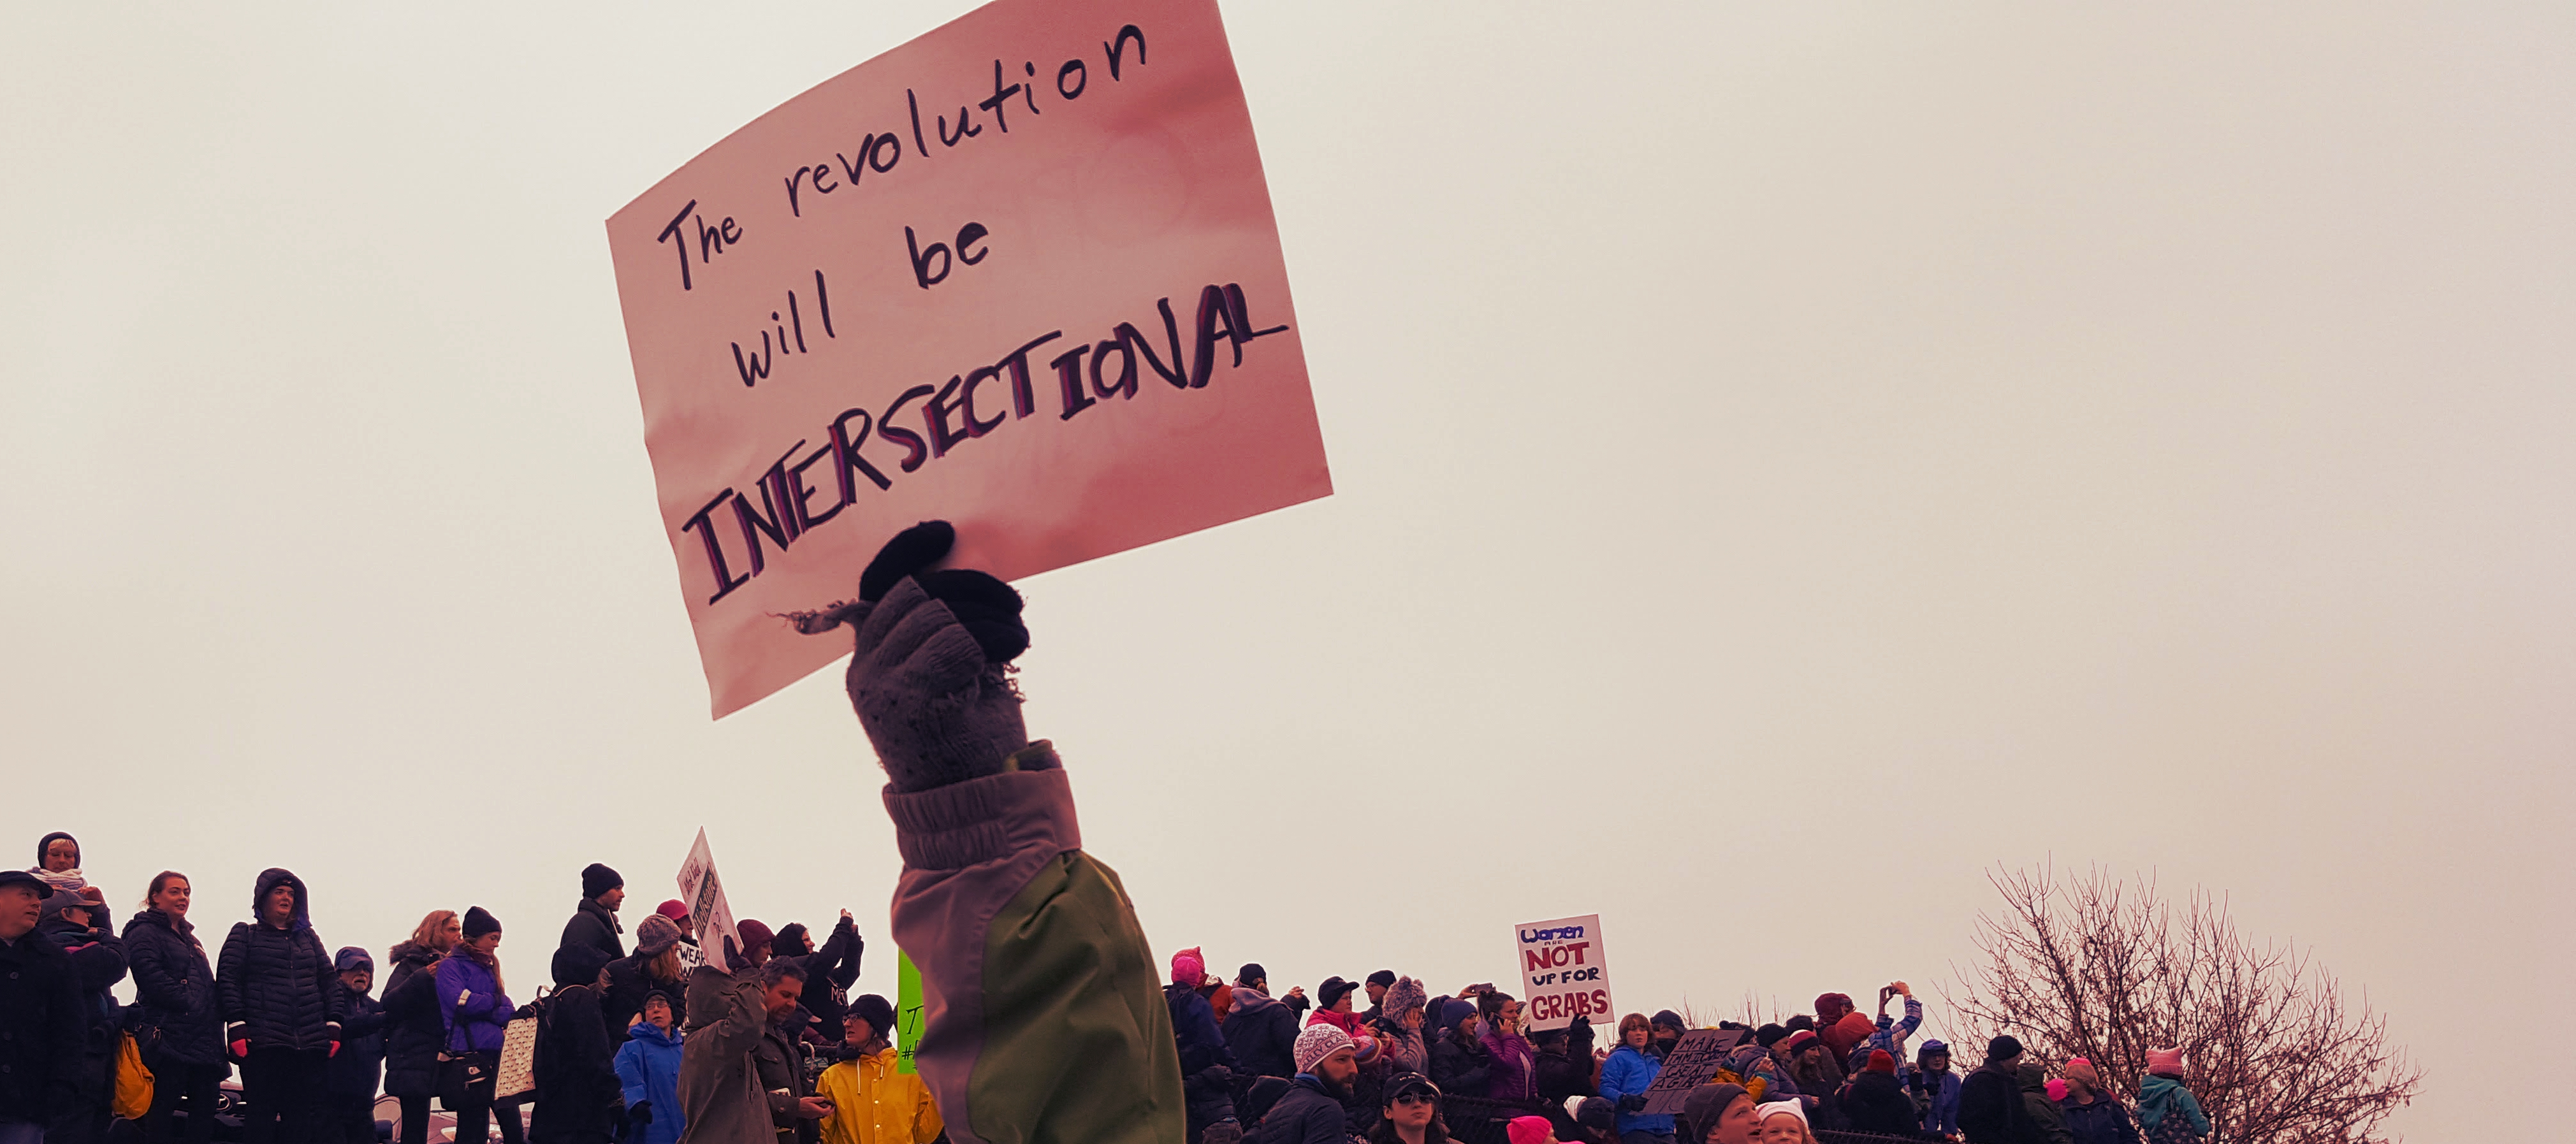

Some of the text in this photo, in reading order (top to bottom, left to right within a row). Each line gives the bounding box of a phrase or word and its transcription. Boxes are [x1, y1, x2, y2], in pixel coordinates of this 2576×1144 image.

[658, 25, 1145, 290] The revolution
[732, 223, 987, 386] will be
[682, 284, 1289, 605] INTERSECTIONAL
[1525, 941, 1590, 972] NOT
[1532, 967, 1602, 986] UP FOR
[1531, 988, 1608, 1020] GRABS
[1679, 1036, 1729, 1052] MAKE
[1666, 1063, 1714, 1078] GREAT
